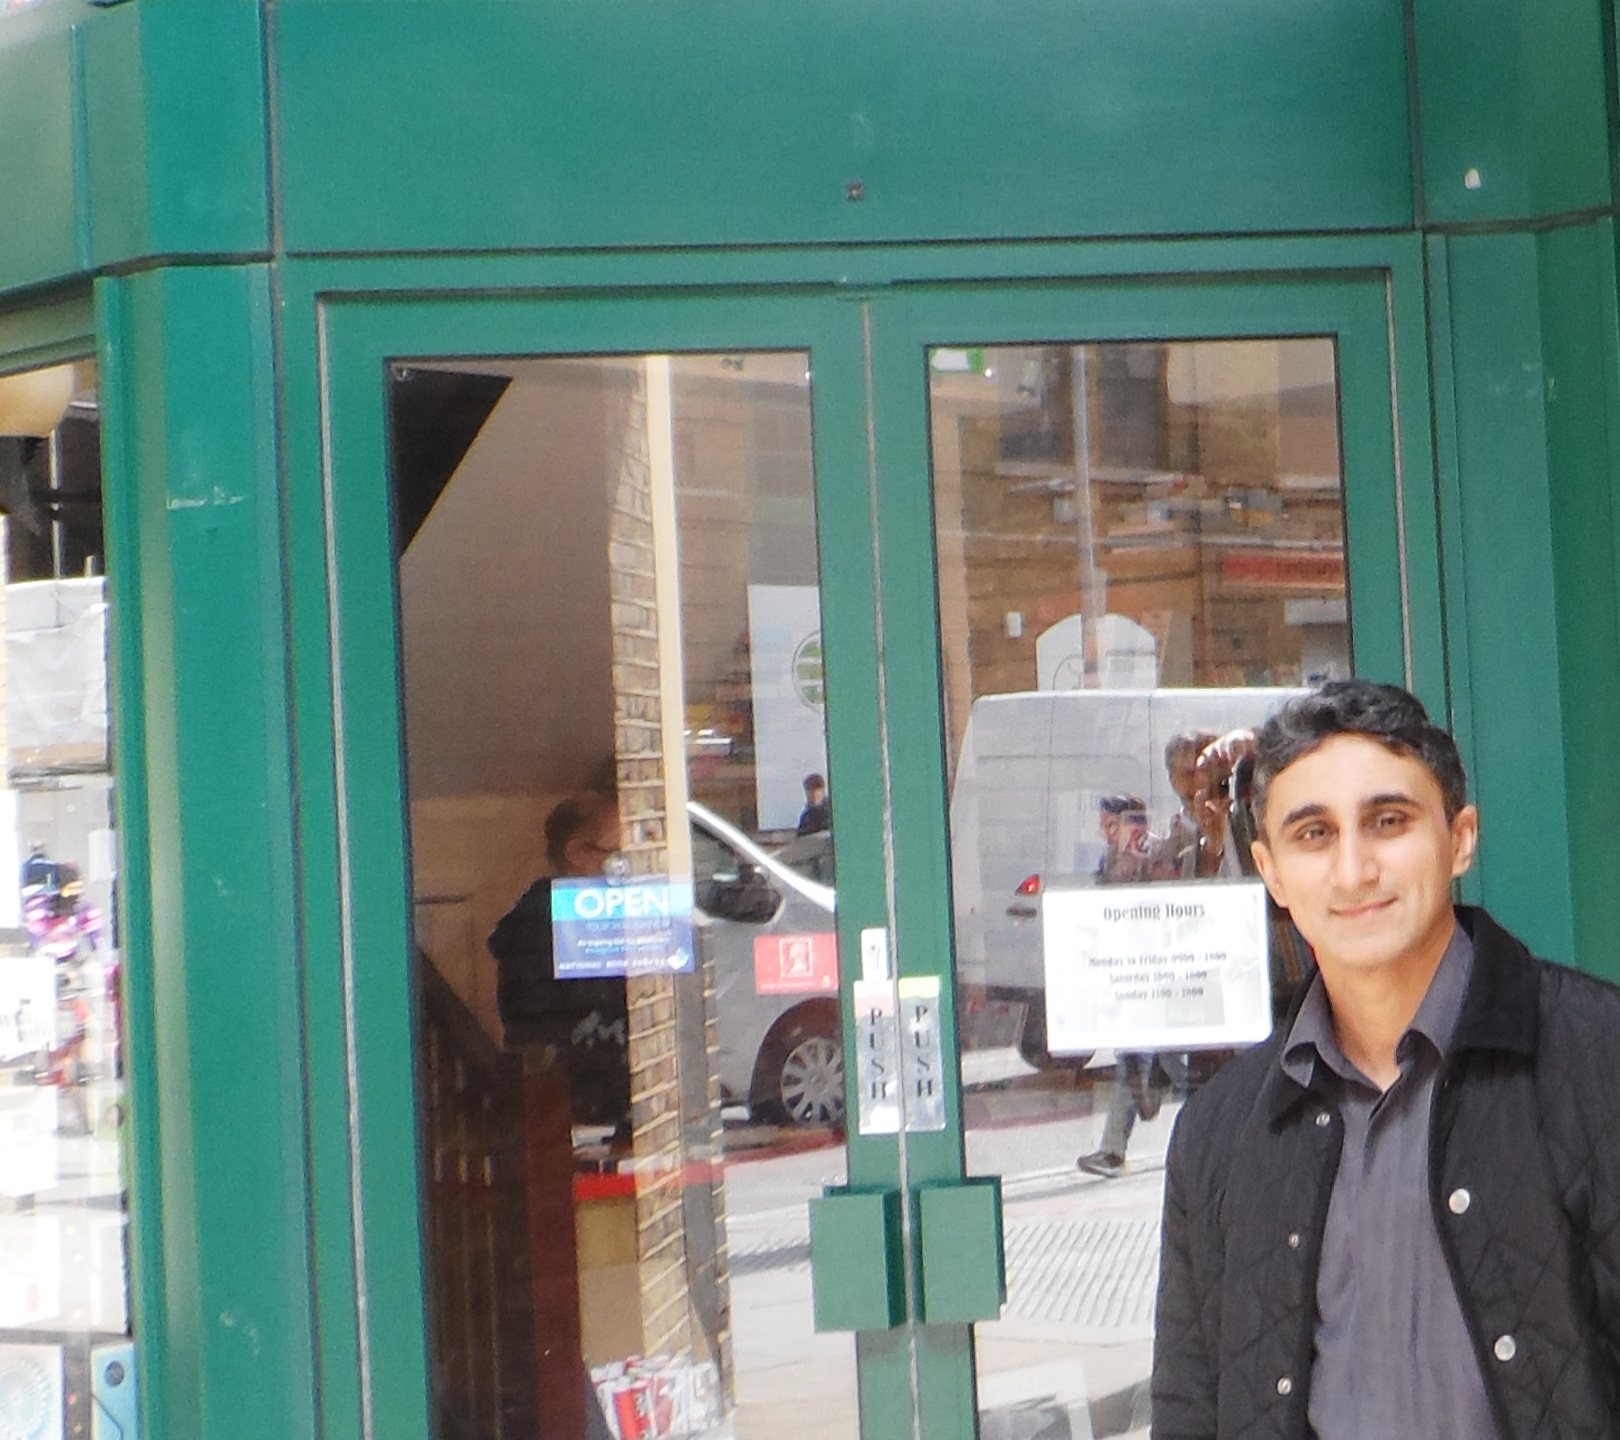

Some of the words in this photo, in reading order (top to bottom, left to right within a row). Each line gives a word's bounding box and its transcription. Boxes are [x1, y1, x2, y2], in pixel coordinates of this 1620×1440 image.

[574, 886, 671, 918] OPEN
[1103, 903, 1162, 923] Opening
[1165, 903, 1206, 919] Hours
[1139, 954, 1168, 967] Friday
[869, 1006, 888, 1100] PUSH
[914, 1004, 935, 1098] PUSH
